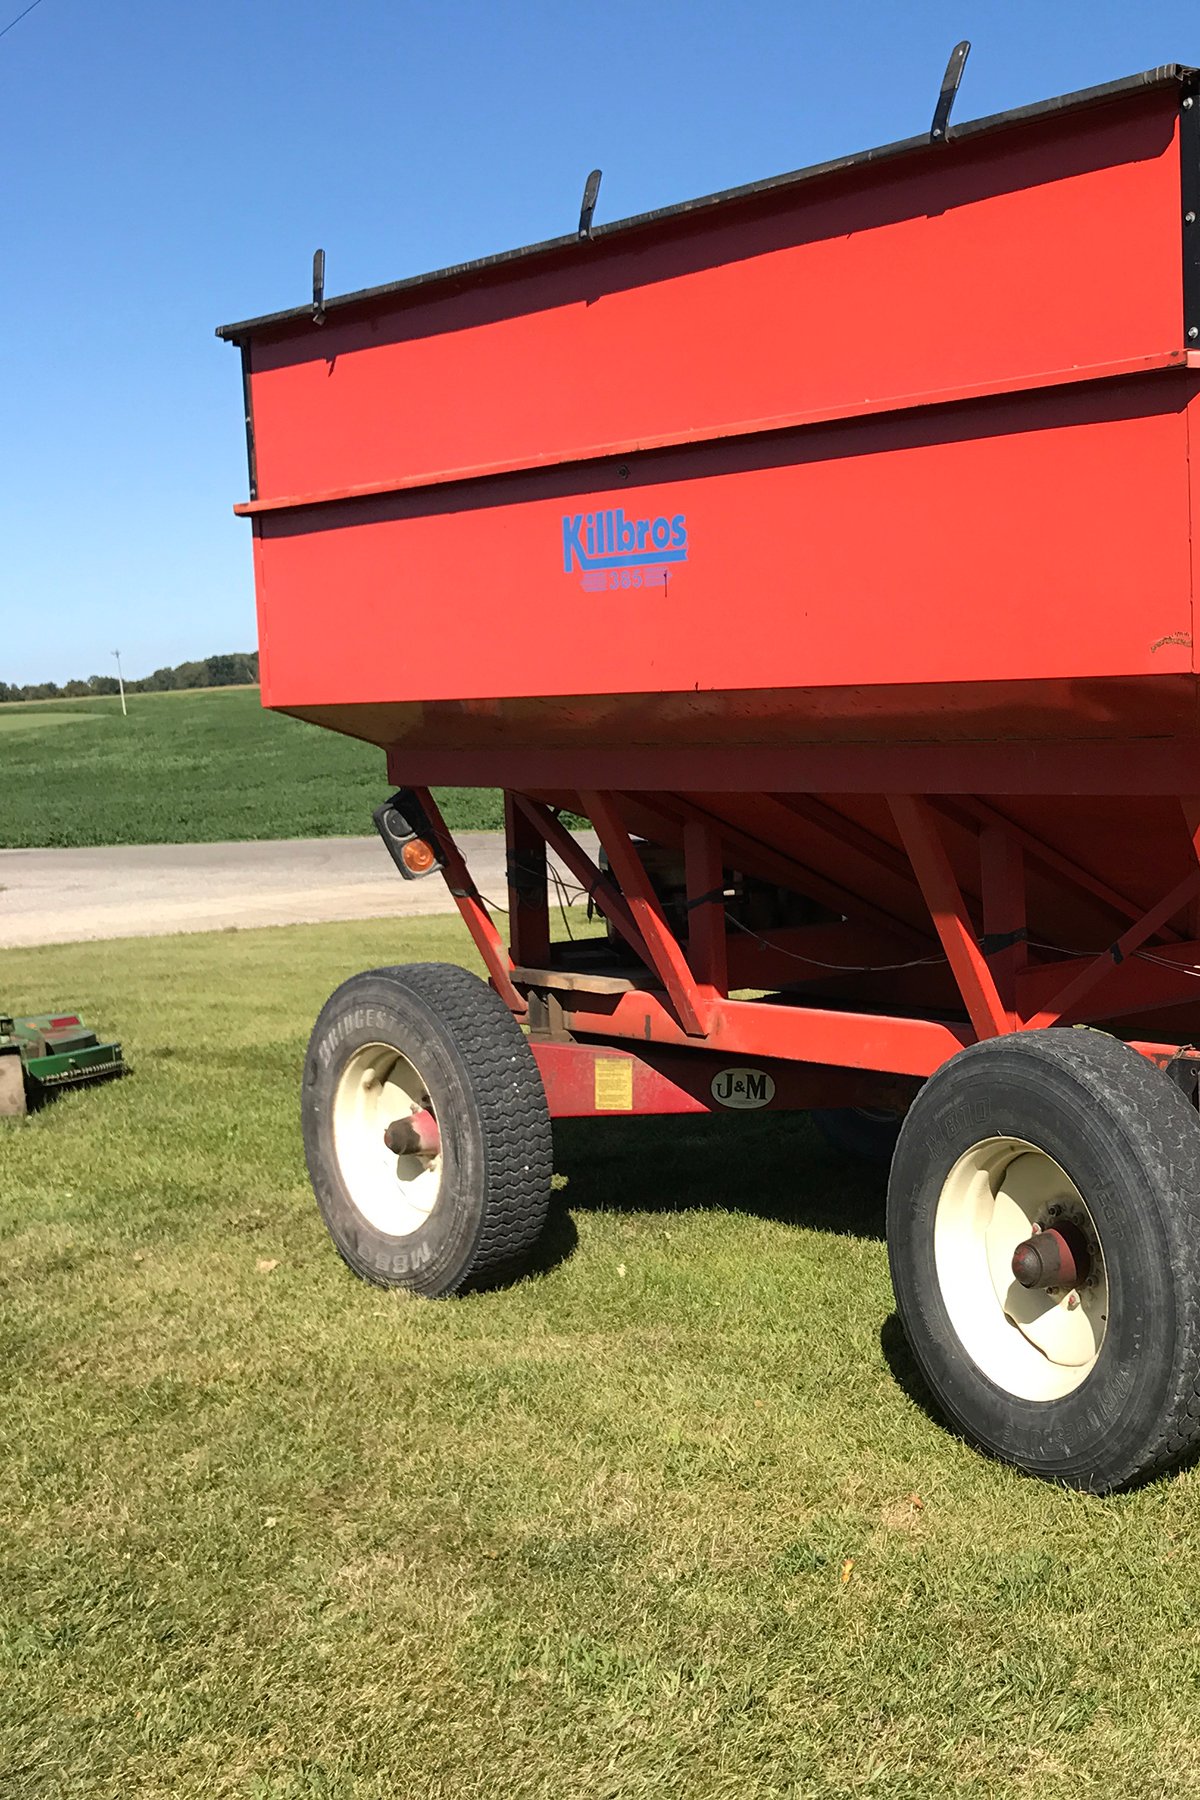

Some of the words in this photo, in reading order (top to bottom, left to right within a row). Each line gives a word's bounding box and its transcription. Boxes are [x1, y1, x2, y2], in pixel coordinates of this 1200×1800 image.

[562, 508, 688, 573] Killbros
[609, 570, 642, 590] 385
[318, 1009, 432, 1068] BRIDGEST
[717, 1073, 767, 1101] J&M
